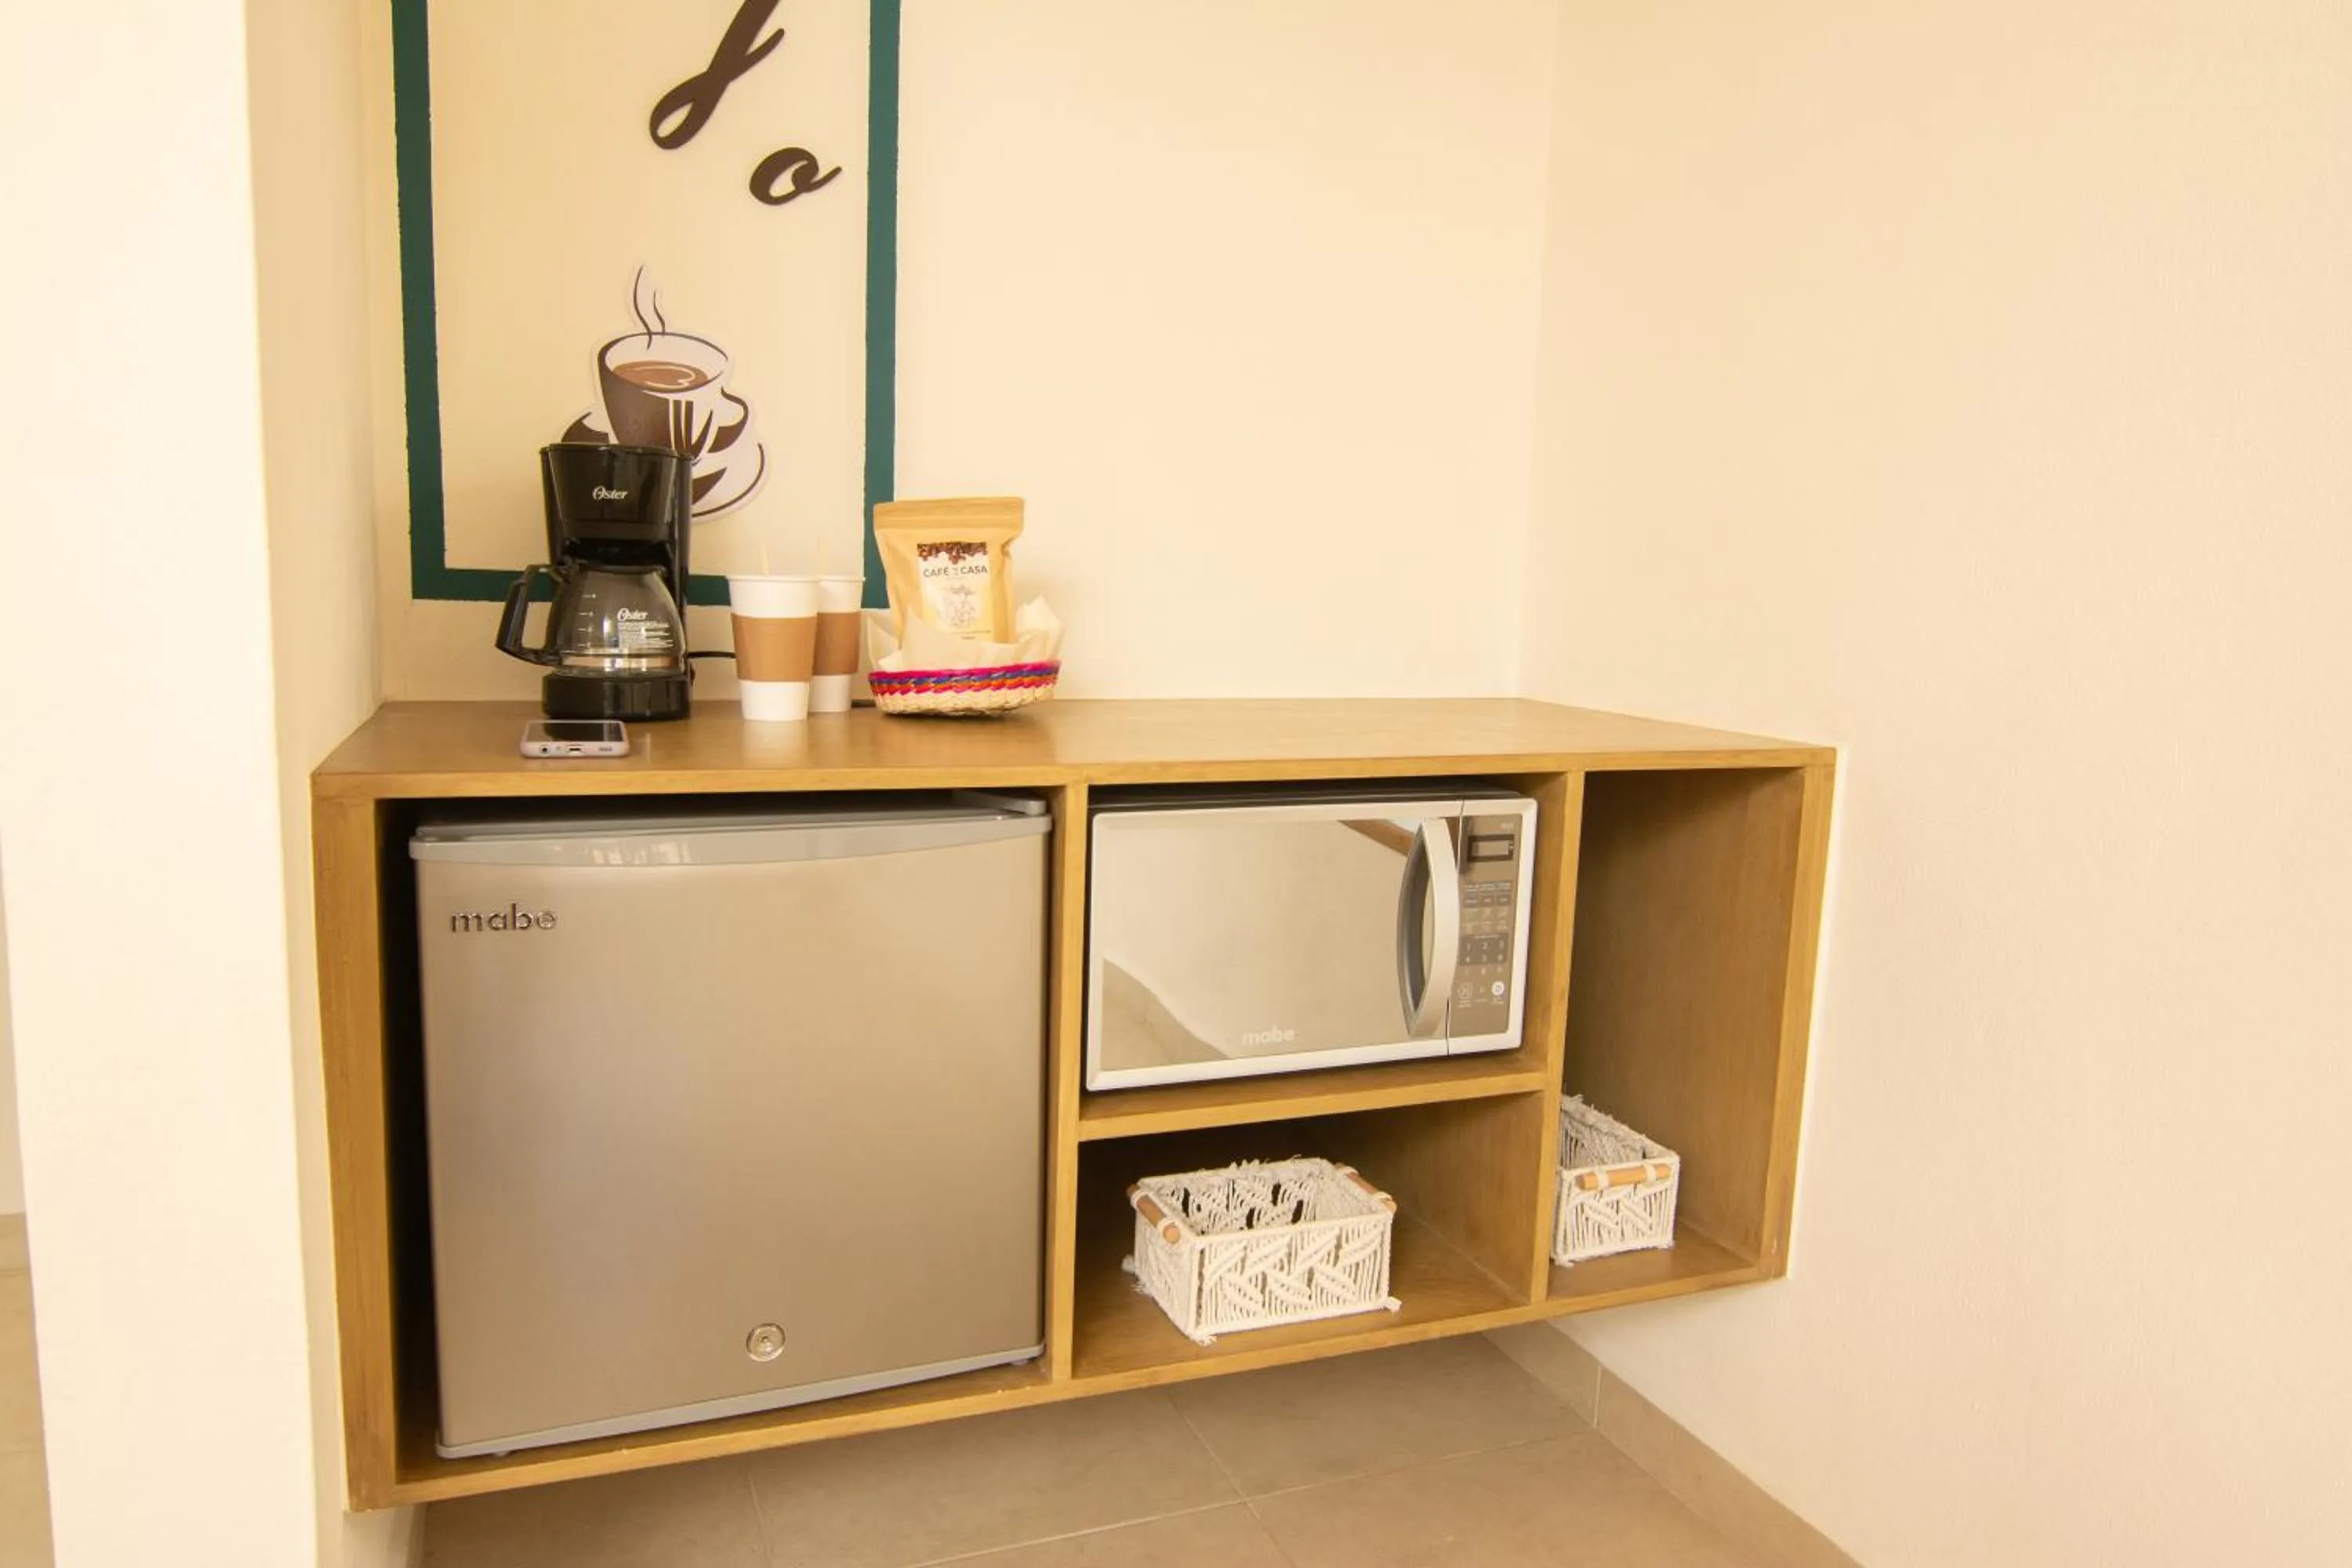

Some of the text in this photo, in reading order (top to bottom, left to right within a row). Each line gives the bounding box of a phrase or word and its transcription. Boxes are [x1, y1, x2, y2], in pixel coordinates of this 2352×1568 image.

[592, 485, 629, 500] Oster
[960, 564, 989, 575] CASA
[617, 608, 648, 622] Oster
[451, 902, 557, 933] mabe
[1242, 1024, 1295, 1045] mabe
